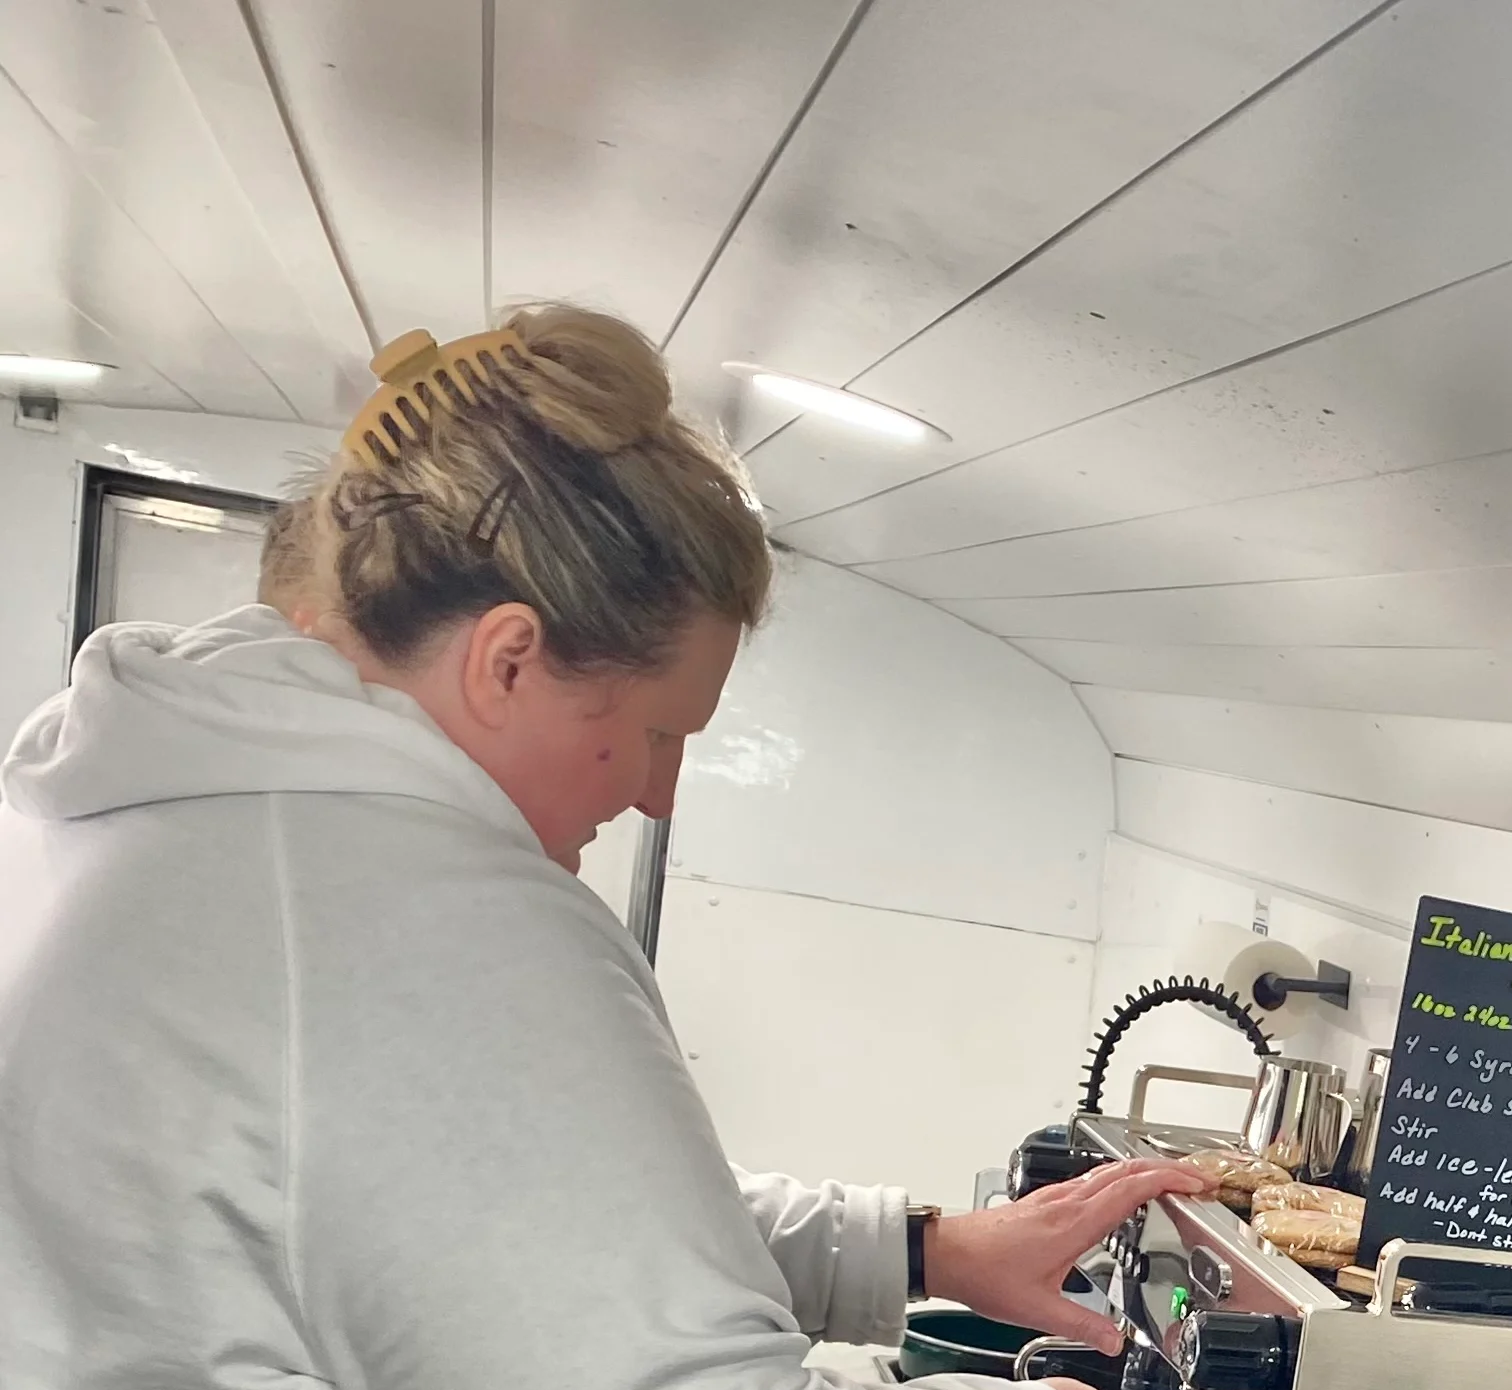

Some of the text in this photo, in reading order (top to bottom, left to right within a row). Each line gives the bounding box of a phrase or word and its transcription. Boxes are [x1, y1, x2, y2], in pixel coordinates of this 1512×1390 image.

[1411, 992, 1512, 1030] 16oz 24oz
[1405, 1035, 1420, 1054] 4
[1446, 1045, 1459, 1064] 6
[1396, 1077, 1438, 1102] Add
[1447, 1087, 1493, 1114] Club
[1390, 1116, 1438, 1140] Stir
[1388, 1144, 1428, 1166] Add
[1379, 1181, 1418, 1203] Add
[1423, 1191, 1467, 1215] half
[1479, 1184, 1507, 1202] for
